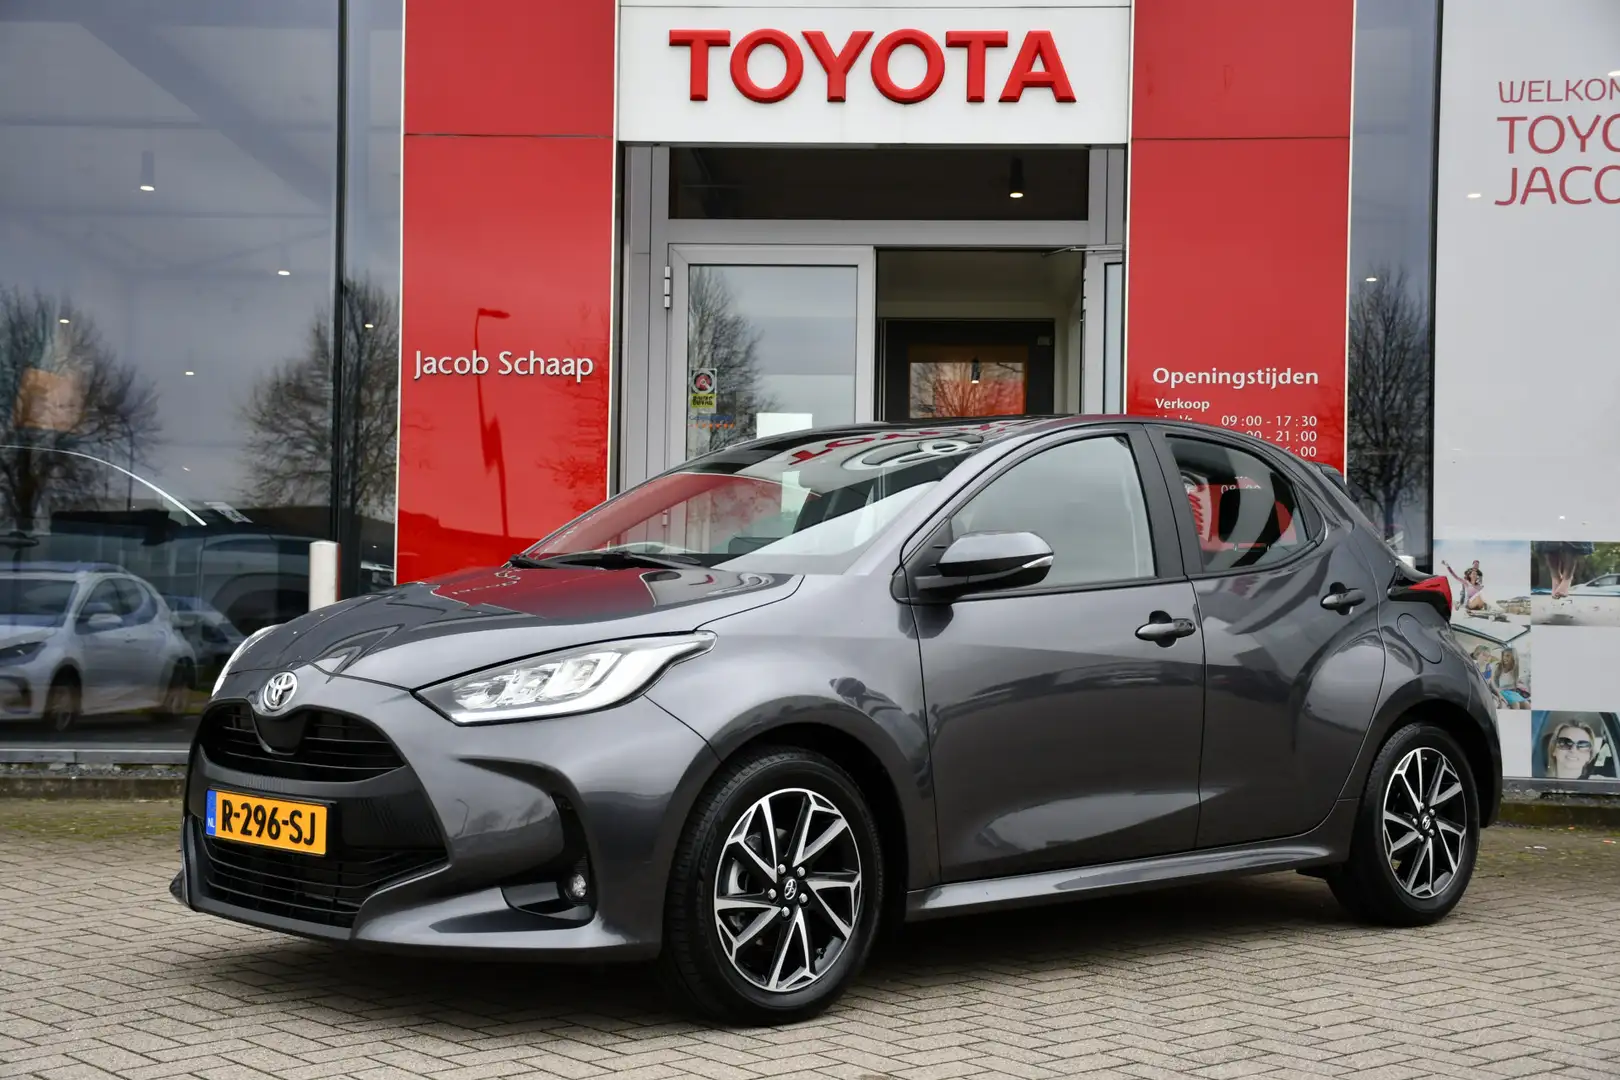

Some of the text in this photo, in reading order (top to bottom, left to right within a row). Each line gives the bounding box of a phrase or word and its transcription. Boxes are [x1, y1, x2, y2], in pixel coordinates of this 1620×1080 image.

[669, 28, 1077, 104] TOYOTA
[1494, 165, 1620, 206] JACO
[413, 350, 594, 383] Jacob Schaap
[1152, 367, 1319, 389] Openingstijden
[1155, 398, 1210, 411] Verkoop
[207, 817, 215, 828] NL
[221, 799, 316, 846] R-296-SJ
